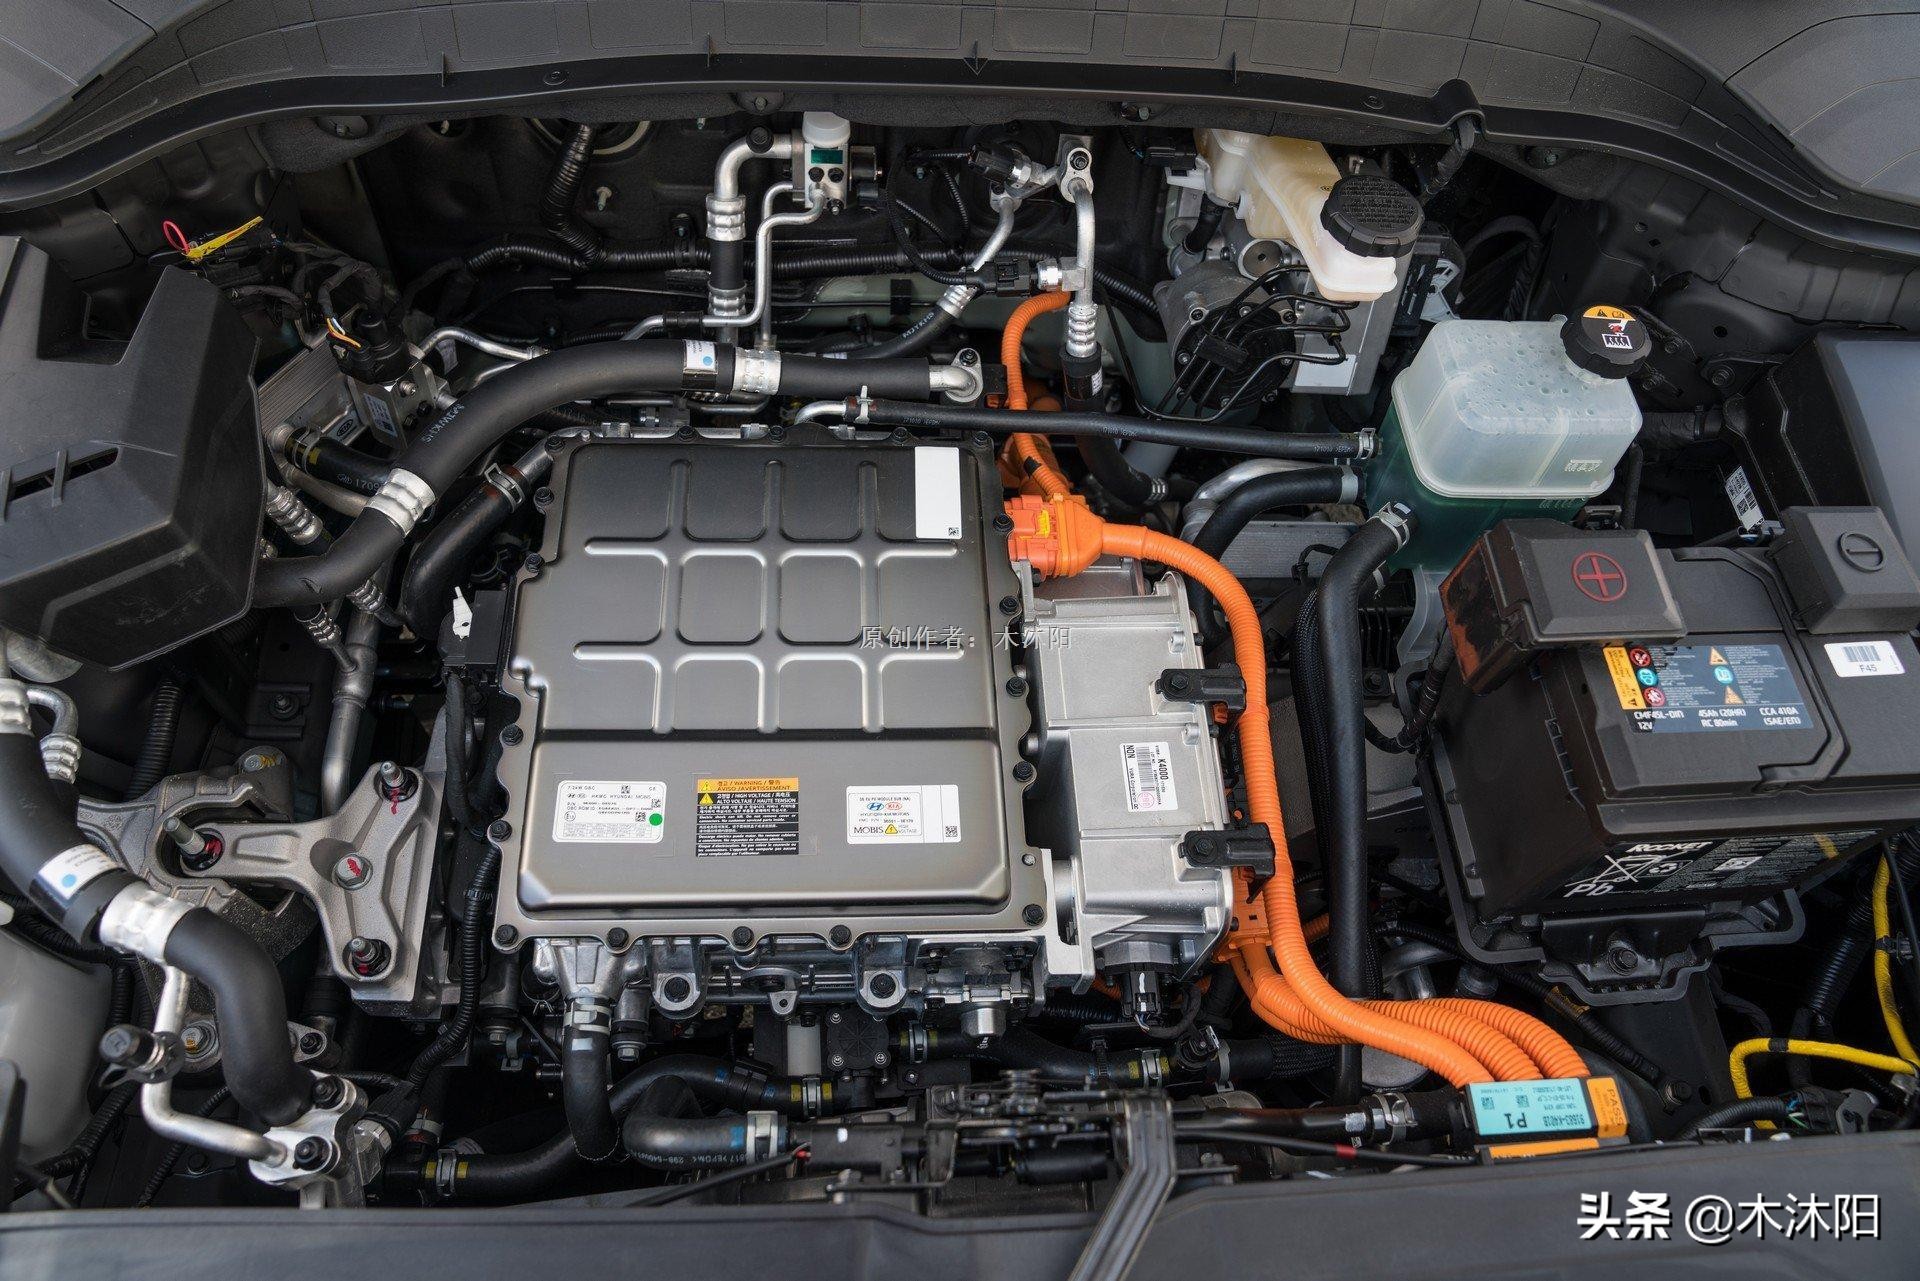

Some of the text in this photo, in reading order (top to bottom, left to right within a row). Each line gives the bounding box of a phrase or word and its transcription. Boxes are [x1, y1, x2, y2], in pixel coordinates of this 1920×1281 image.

[1859, 664, 1877, 672] F45
[1698, 709, 1719, 718] 45Ah
[1758, 707, 1777, 716] CCA
[1638, 721, 1653, 730] 12V
[1700, 719, 1712, 728] RC
[1713, 719, 1738, 728] 80min
[1158, 758, 1169, 780] K4000
[1625, 841, 1714, 853] ROCKET
[1563, 882, 1614, 898] Pb
[1504, 1112, 1528, 1129] P1
